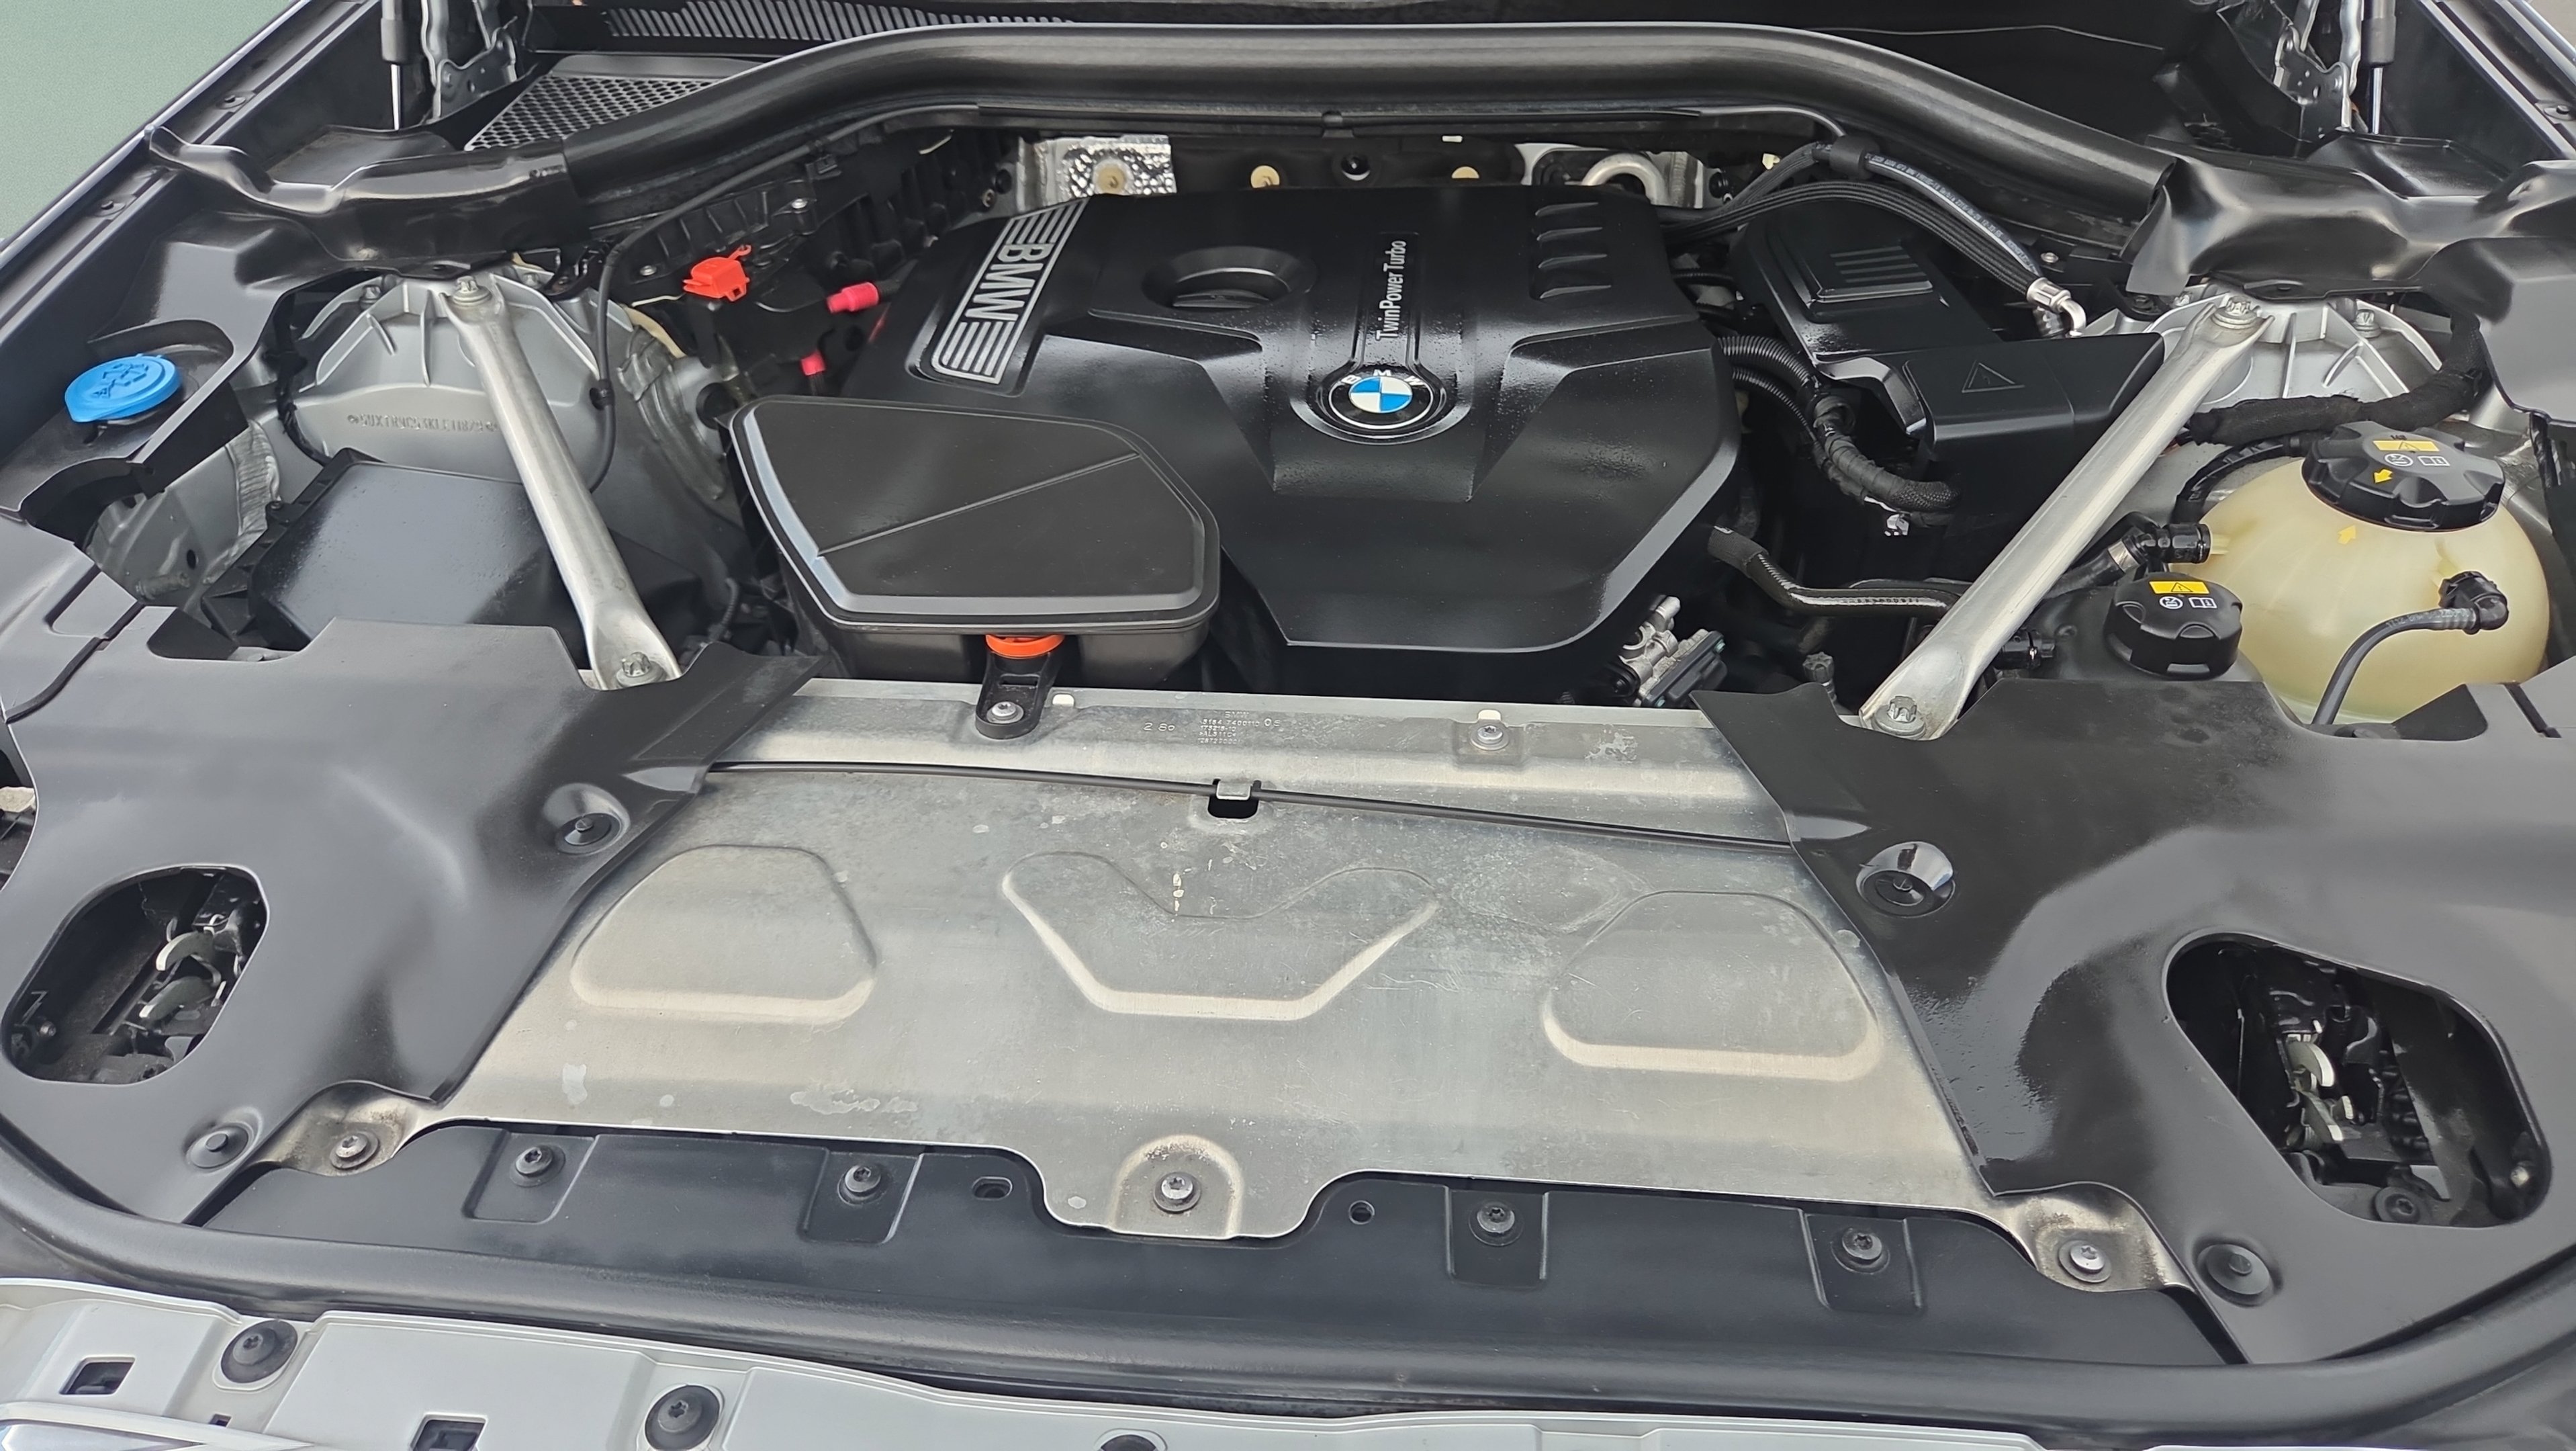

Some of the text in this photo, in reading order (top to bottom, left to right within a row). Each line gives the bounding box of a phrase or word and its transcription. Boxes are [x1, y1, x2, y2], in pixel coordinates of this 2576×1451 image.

[964, 243, 1056, 321] BMW
[1376, 240, 1407, 340] TwinPower Turbo
